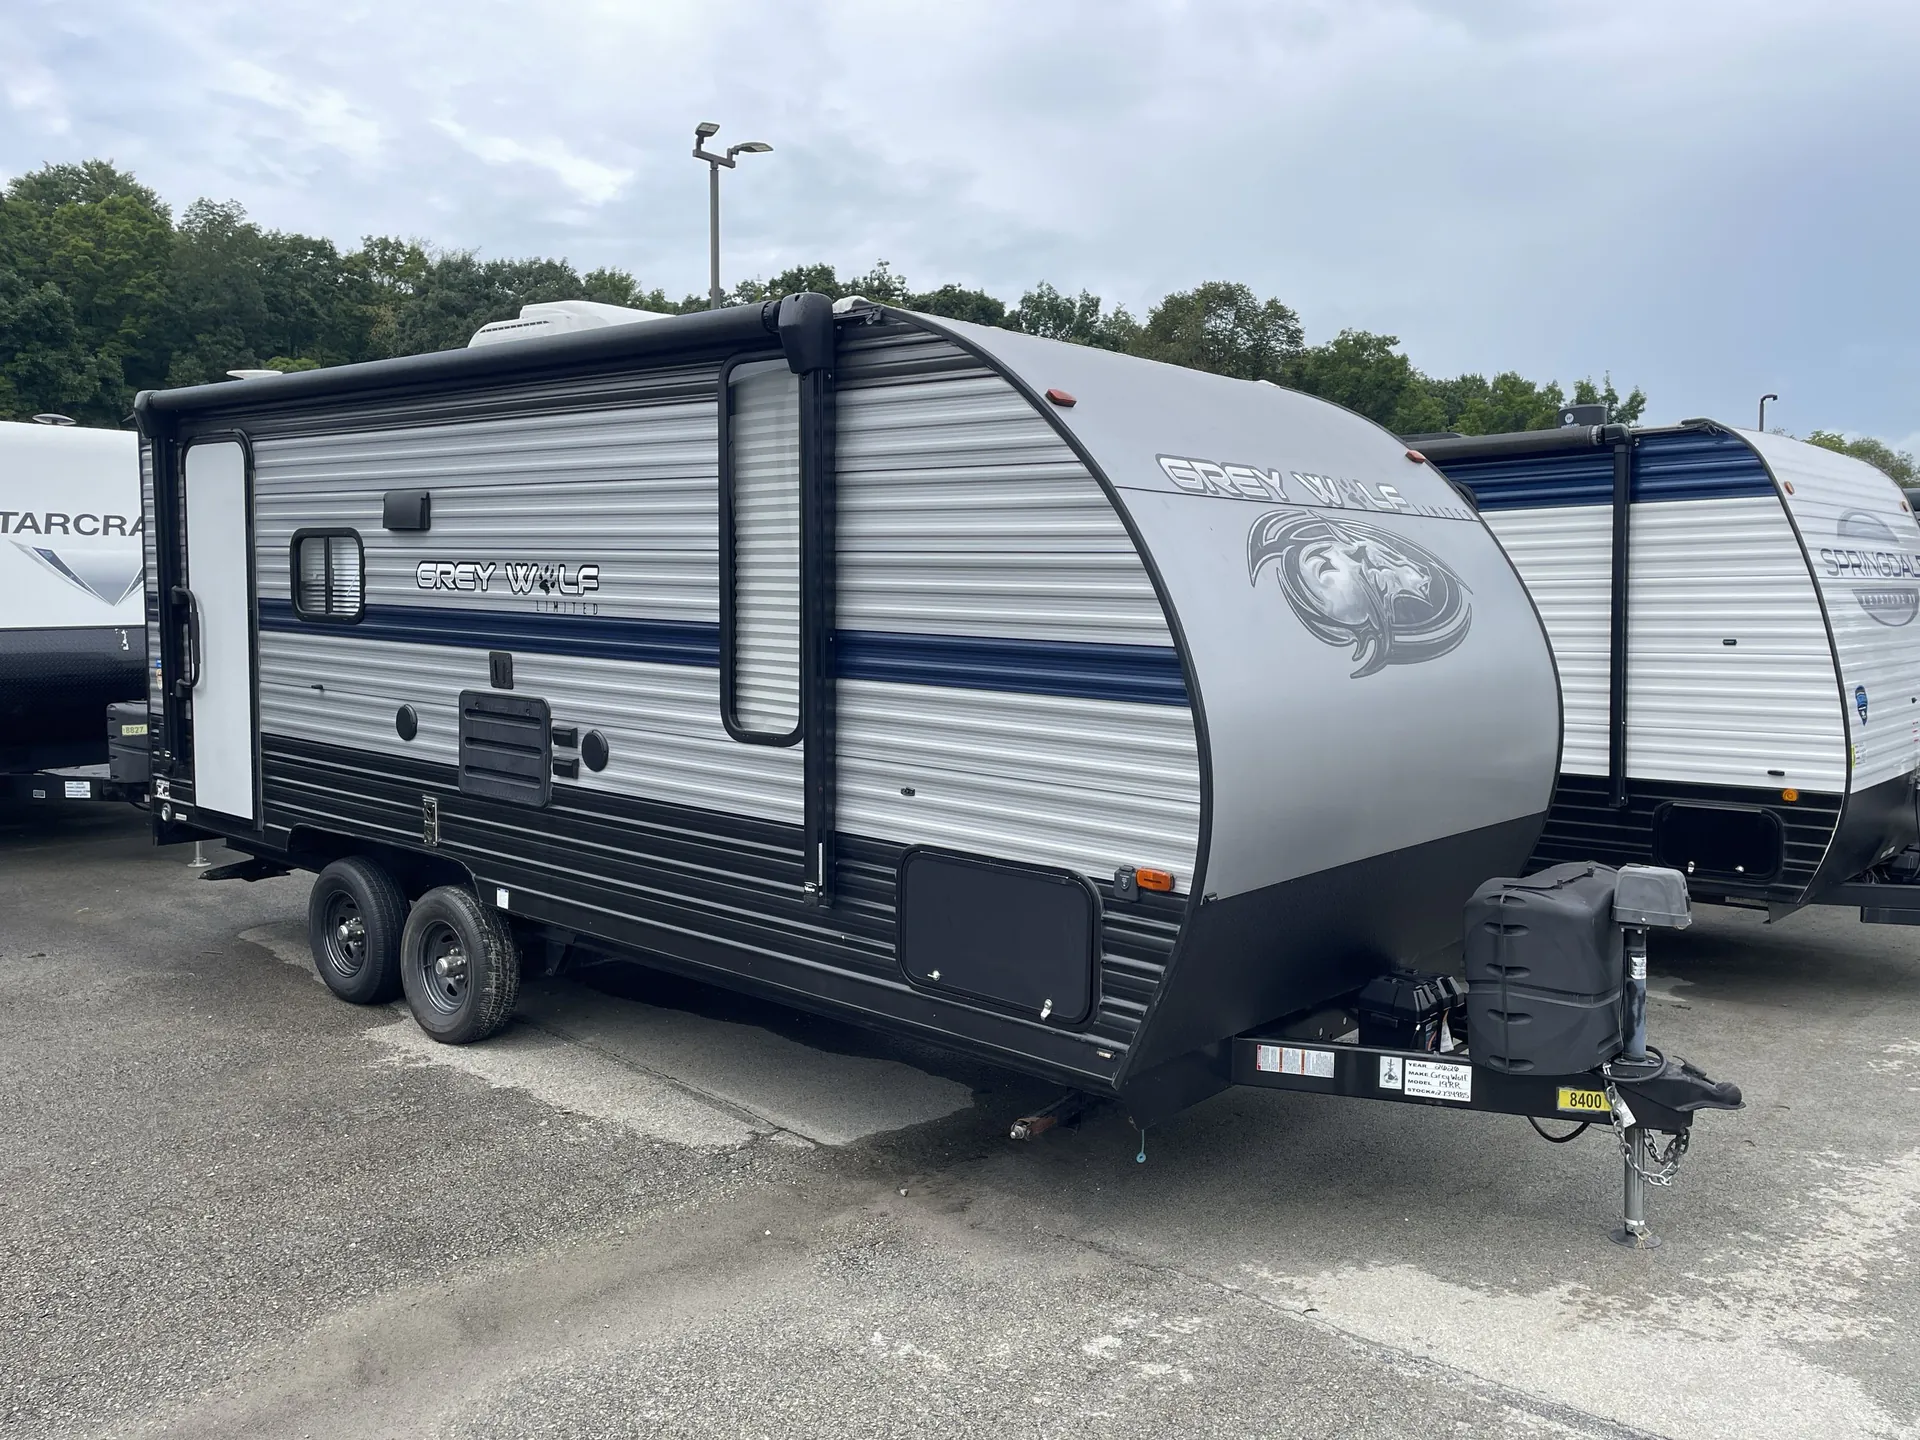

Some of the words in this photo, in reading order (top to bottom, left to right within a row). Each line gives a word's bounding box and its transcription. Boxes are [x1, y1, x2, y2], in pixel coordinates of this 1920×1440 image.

[1155, 453, 1289, 502] GREY
[416, 560, 497, 592] GREY
[535, 600, 599, 615] LIMITED
[1569, 1092, 1602, 1109] 8400
